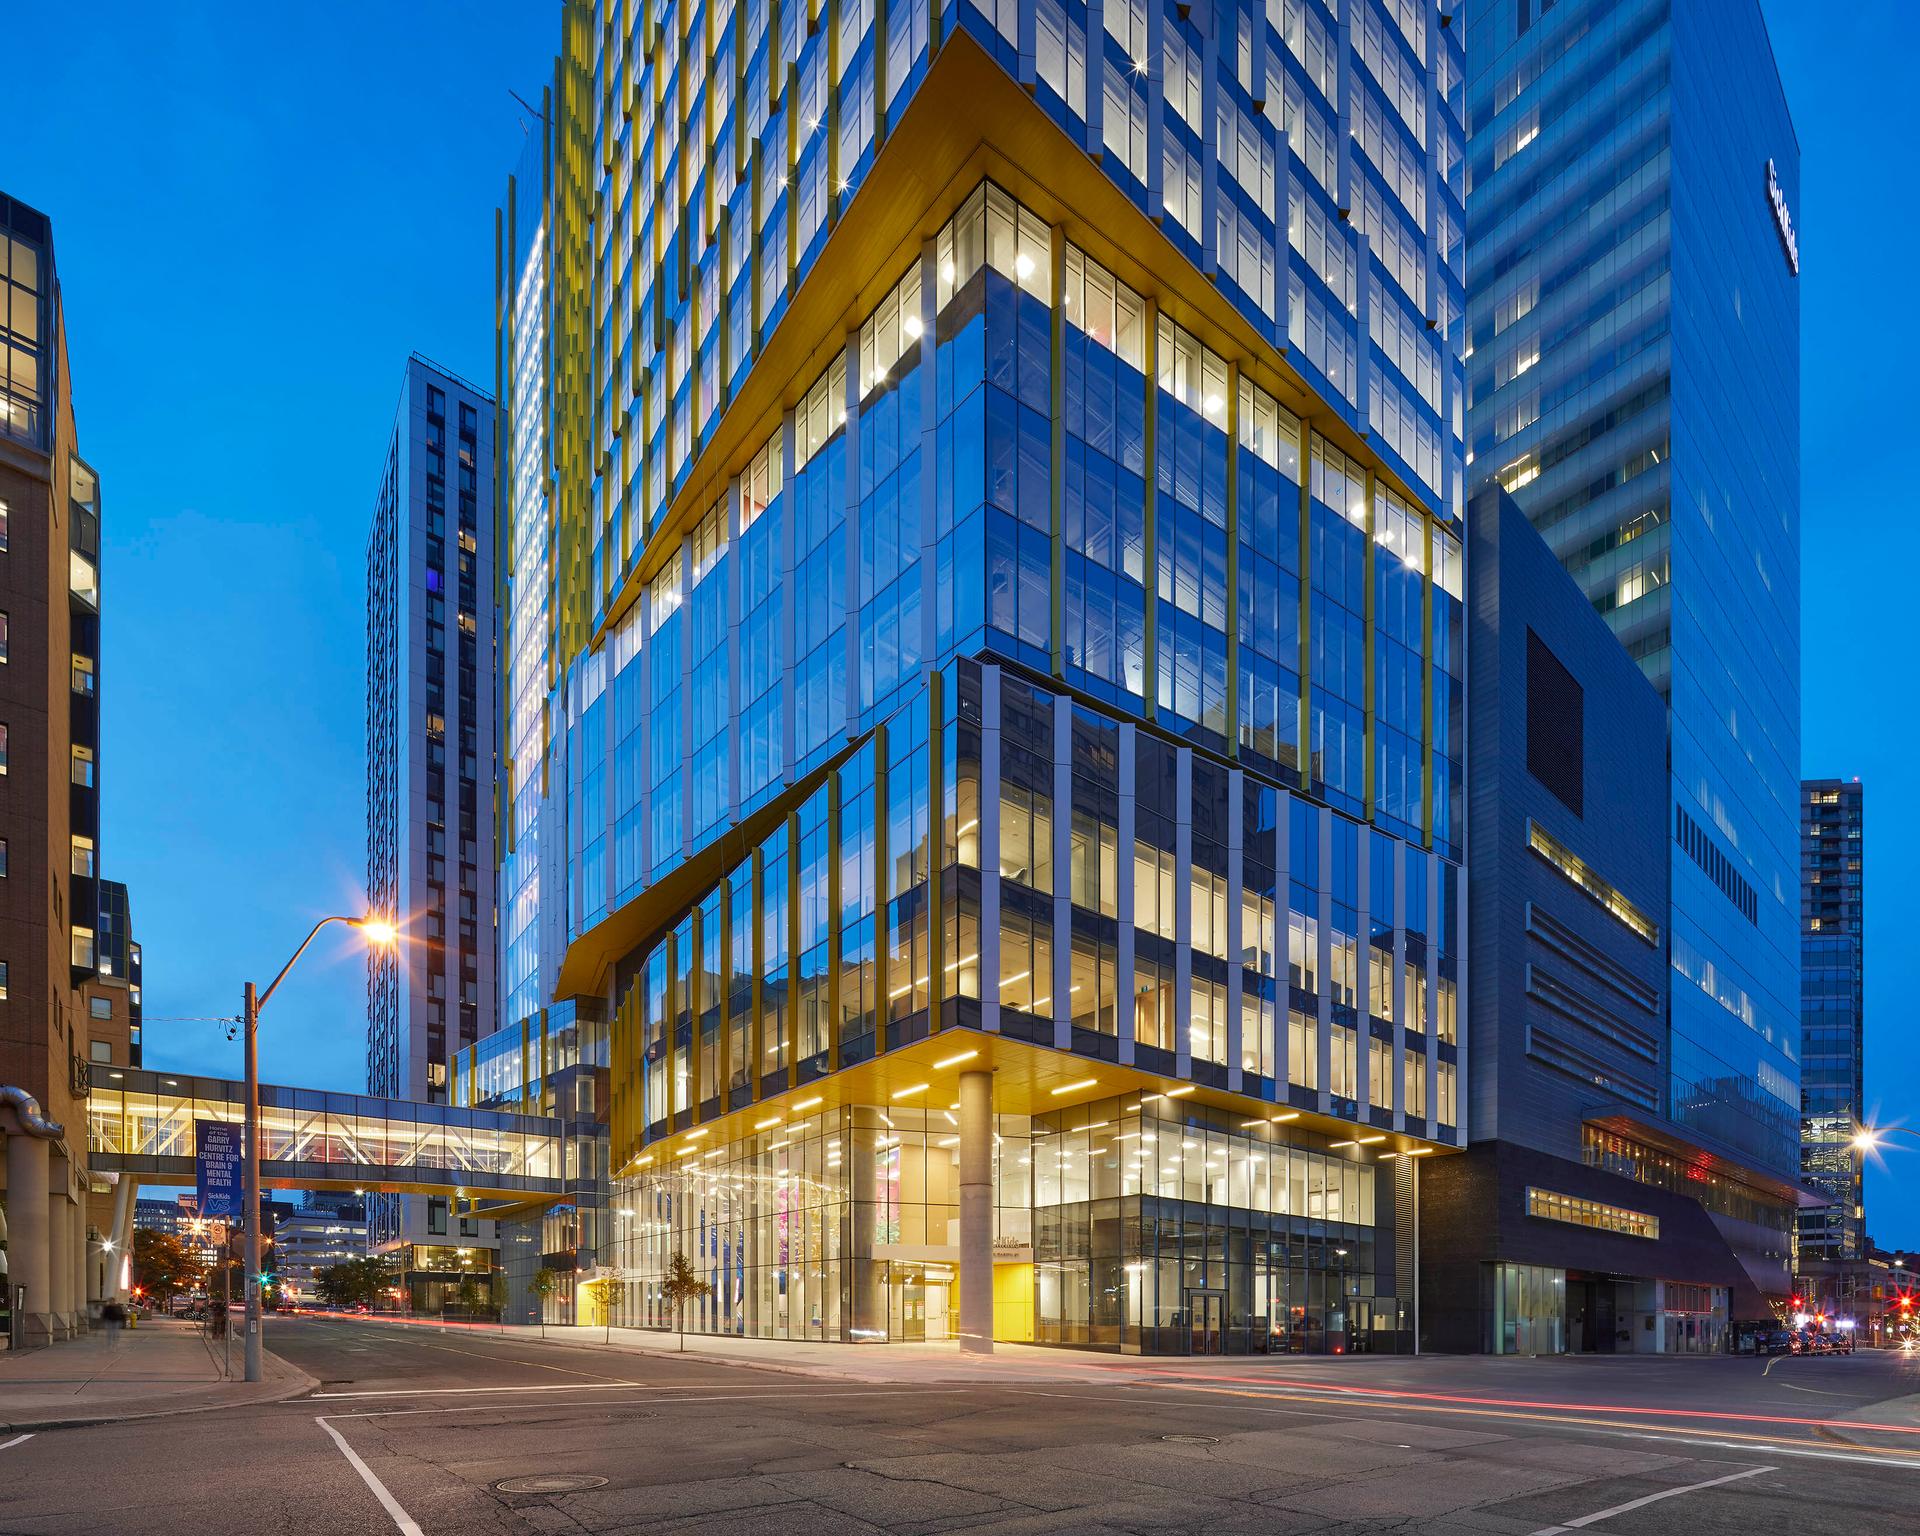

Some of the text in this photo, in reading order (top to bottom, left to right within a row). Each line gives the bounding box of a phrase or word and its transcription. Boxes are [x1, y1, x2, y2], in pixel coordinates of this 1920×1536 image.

[207, 1135, 230, 1144] GARRY
[204, 1144, 233, 1153] HURVITZ
[199, 1151, 239, 1162] CENTRE FOR
[205, 1161, 226, 1169] BRAIN
[206, 1169, 232, 1178] MENTAL
[207, 1178, 232, 1186] HEALTH
[208, 1199, 231, 1212] VS
